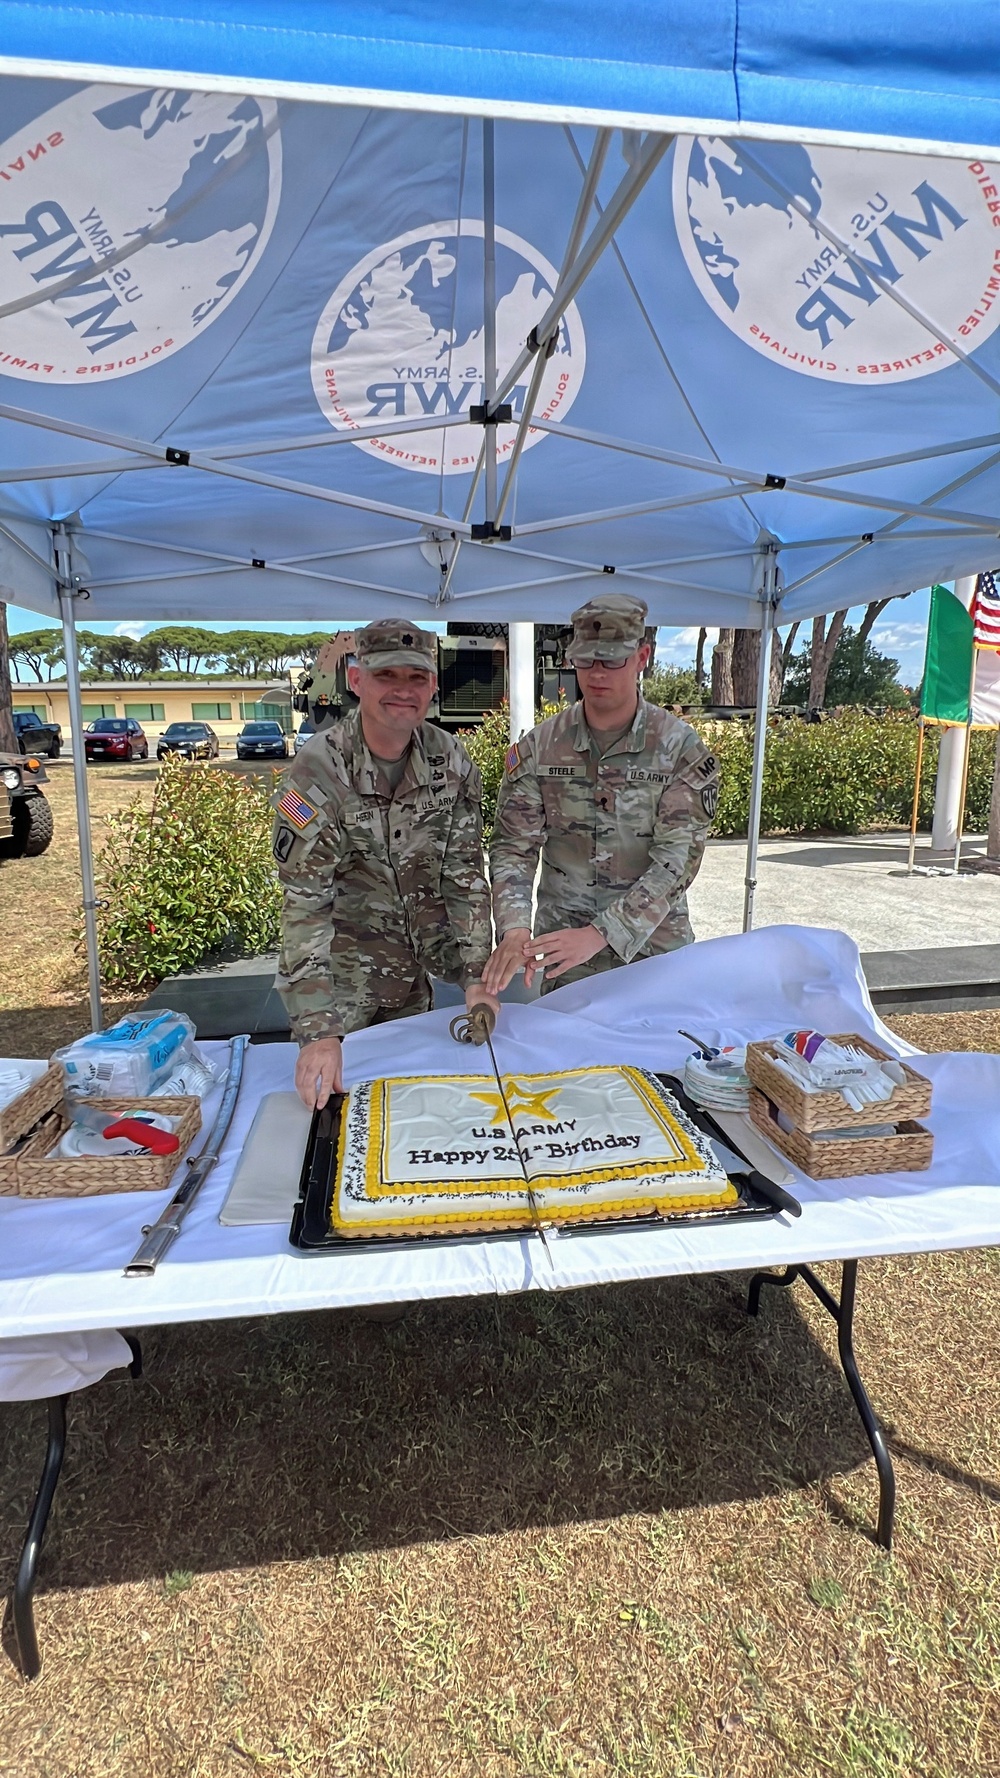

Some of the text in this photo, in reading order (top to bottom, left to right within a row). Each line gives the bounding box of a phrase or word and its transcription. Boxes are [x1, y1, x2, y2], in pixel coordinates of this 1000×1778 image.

[548, 767, 576, 776] STEELE
[697, 756, 715, 779] MP
[630, 771, 670, 784] U.S. ARMY
[421, 796, 455, 811] U.S. ARM
[512, 1119, 577, 1141] ARMY
[408, 1149, 490, 1165] Happy
[545, 1133, 641, 1158] Birthday
